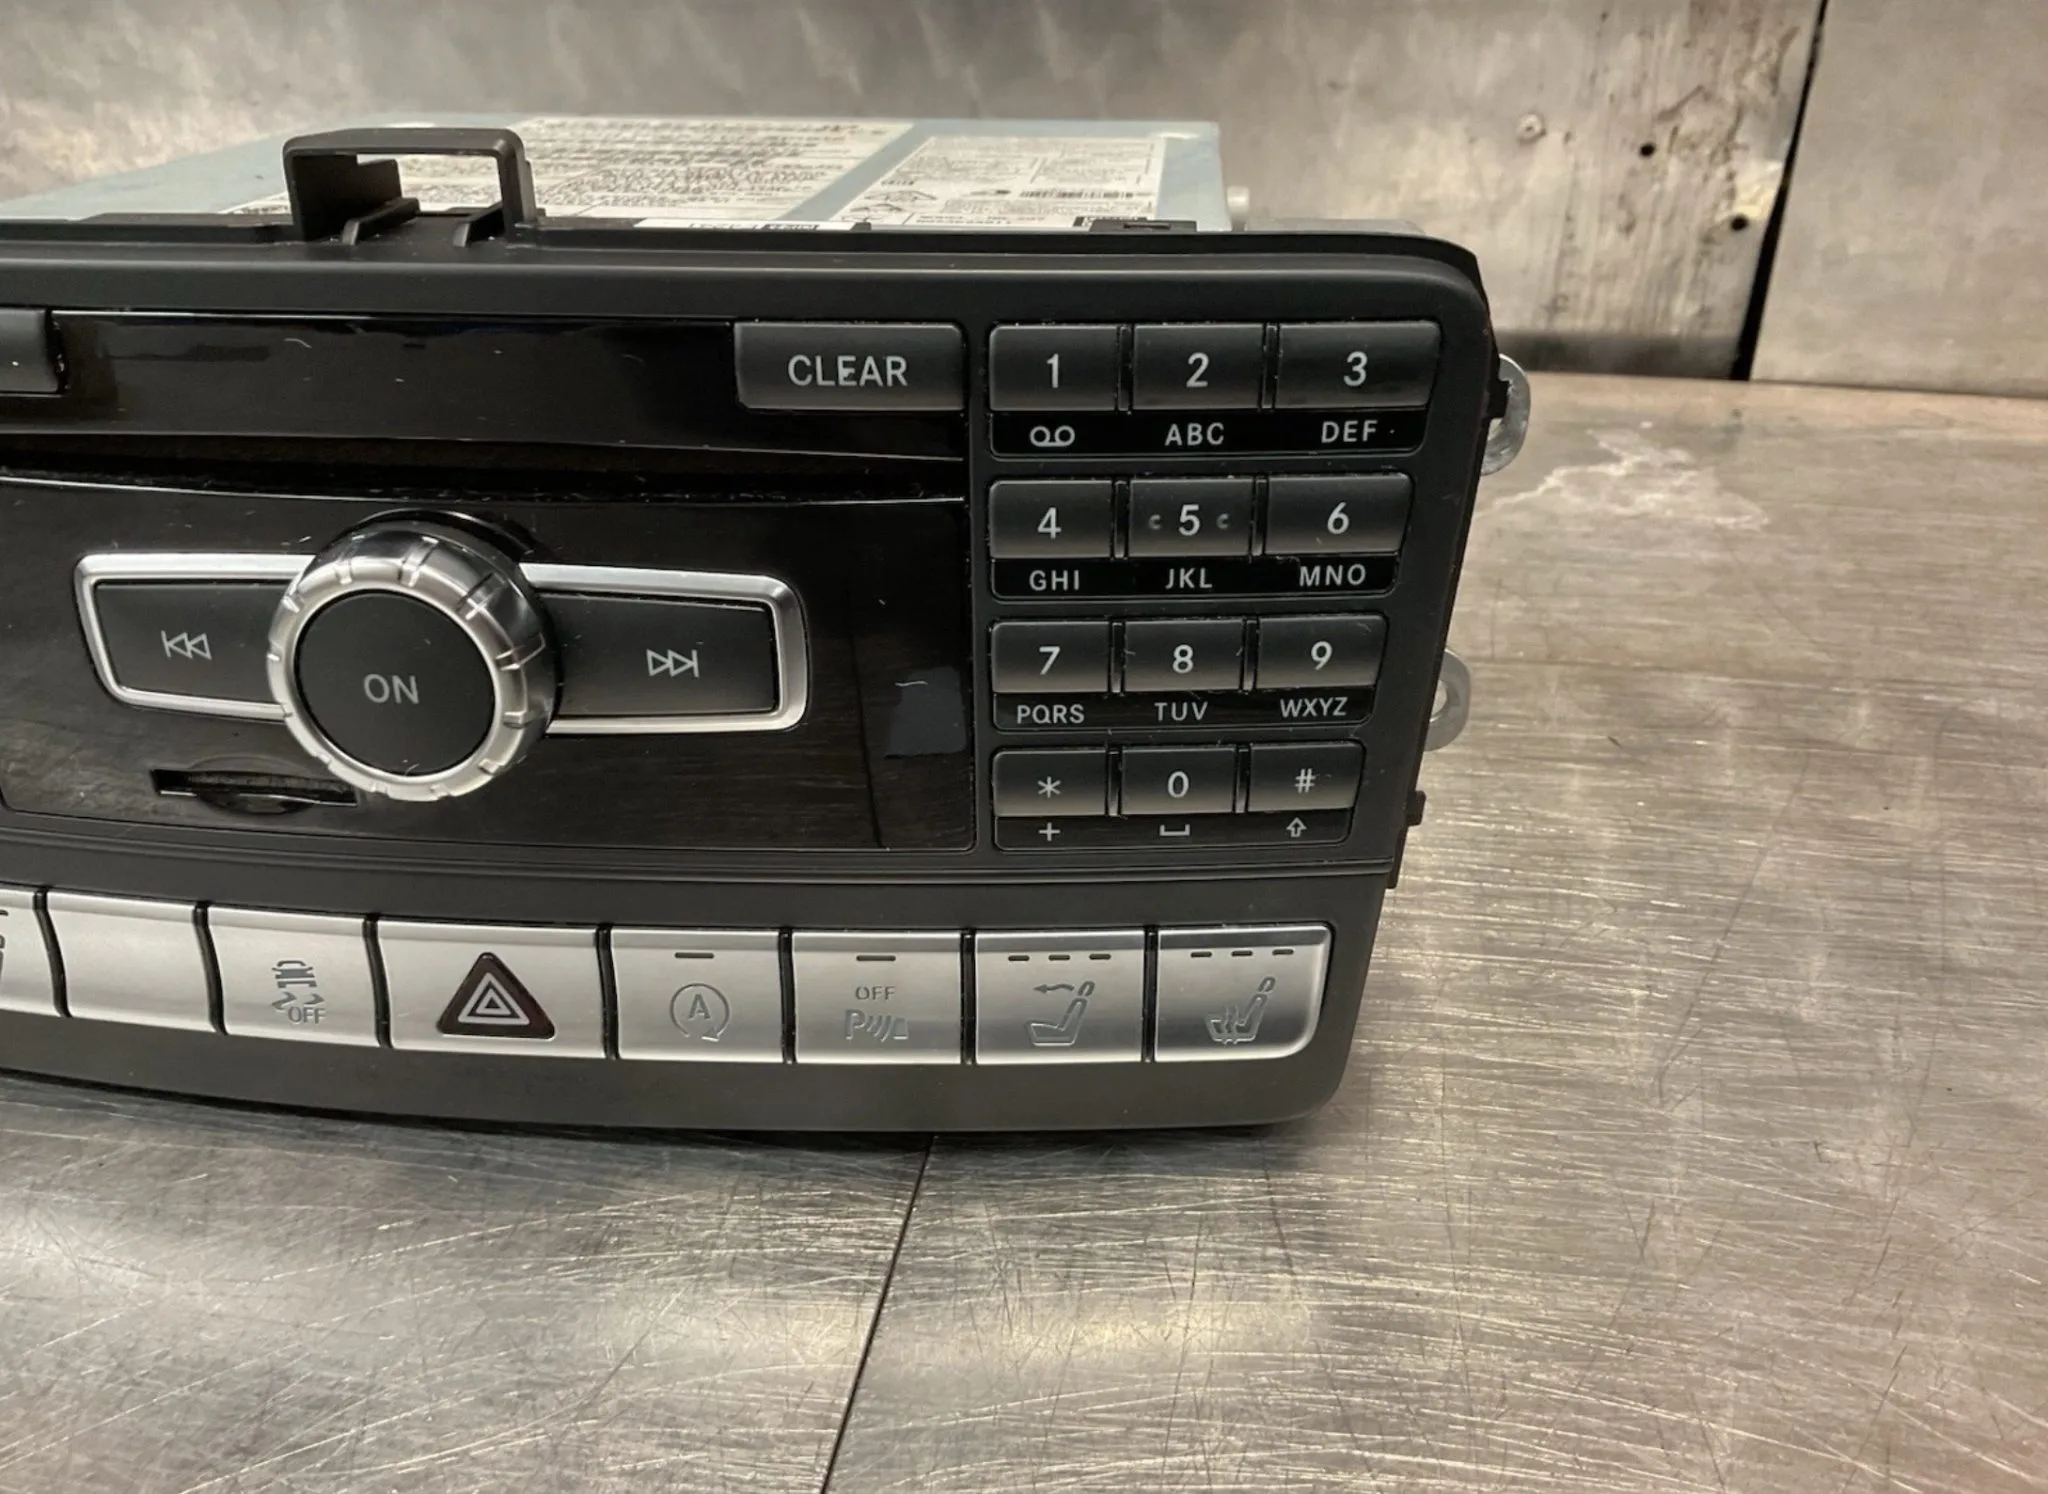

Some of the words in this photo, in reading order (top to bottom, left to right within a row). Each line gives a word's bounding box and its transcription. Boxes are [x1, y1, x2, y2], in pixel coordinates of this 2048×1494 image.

[788, 354, 907, 387] CLEAR
[1045, 353, 1059, 388] 1
[1186, 352, 1209, 388] 2
[1343, 351, 1368, 386] 3
[1164, 422, 1225, 446] ABC
[1321, 419, 1377, 444] DEF
[1038, 507, 1061, 539] 4
[1178, 504, 1200, 536] 5
[1327, 502, 1349, 534] 6
[1029, 569, 1081, 592] GHI
[1165, 567, 1213, 590] JKL
[1299, 563, 1366, 588] MNO
[1039, 646, 1060, 675] 7
[1172, 644, 1194, 673] 8
[1310, 641, 1333, 670] 9
[363, 673, 420, 705] ON
[1016, 704, 1085, 725] PQRS
[1154, 701, 1208, 722] TUV
[1280, 696, 1349, 718] WXYZ
[688, 993, 711, 1020] A
[855, 986, 896, 1001] OFF
[288, 1006, 326, 1024] OFF
